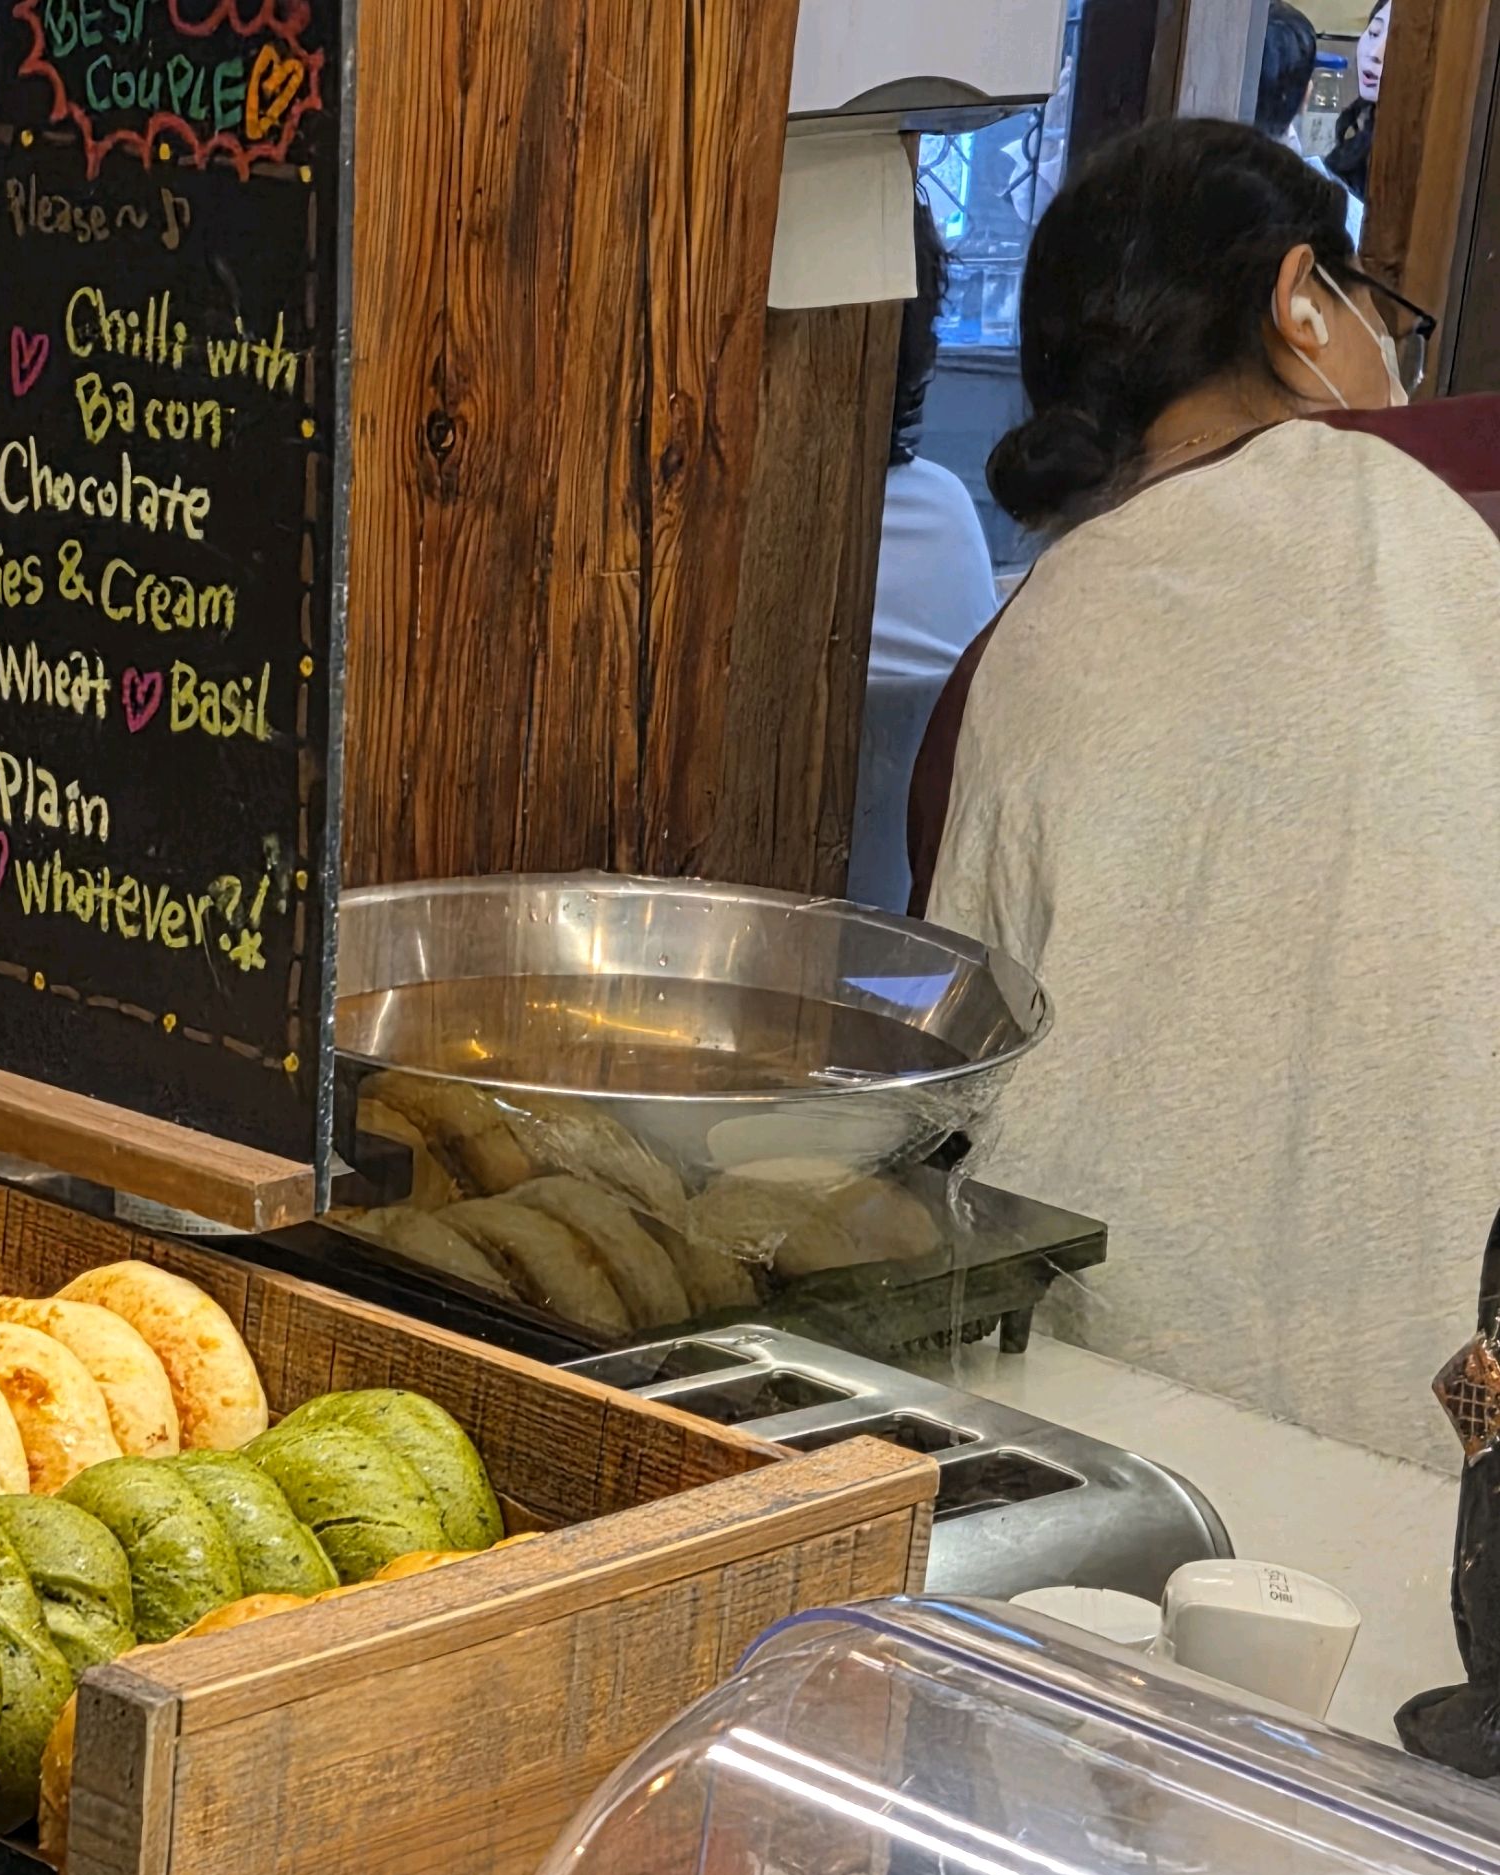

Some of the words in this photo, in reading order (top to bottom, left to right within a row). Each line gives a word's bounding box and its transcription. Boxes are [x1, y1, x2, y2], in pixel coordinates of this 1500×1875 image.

[86, 53, 247, 131] COUPLE
[207, 310, 298, 393] with
[75, 371, 223, 449] Bacon
[57, 539, 95, 605] &
[100, 558, 236, 631] Cream
[170, 659, 273, 741] Basil
